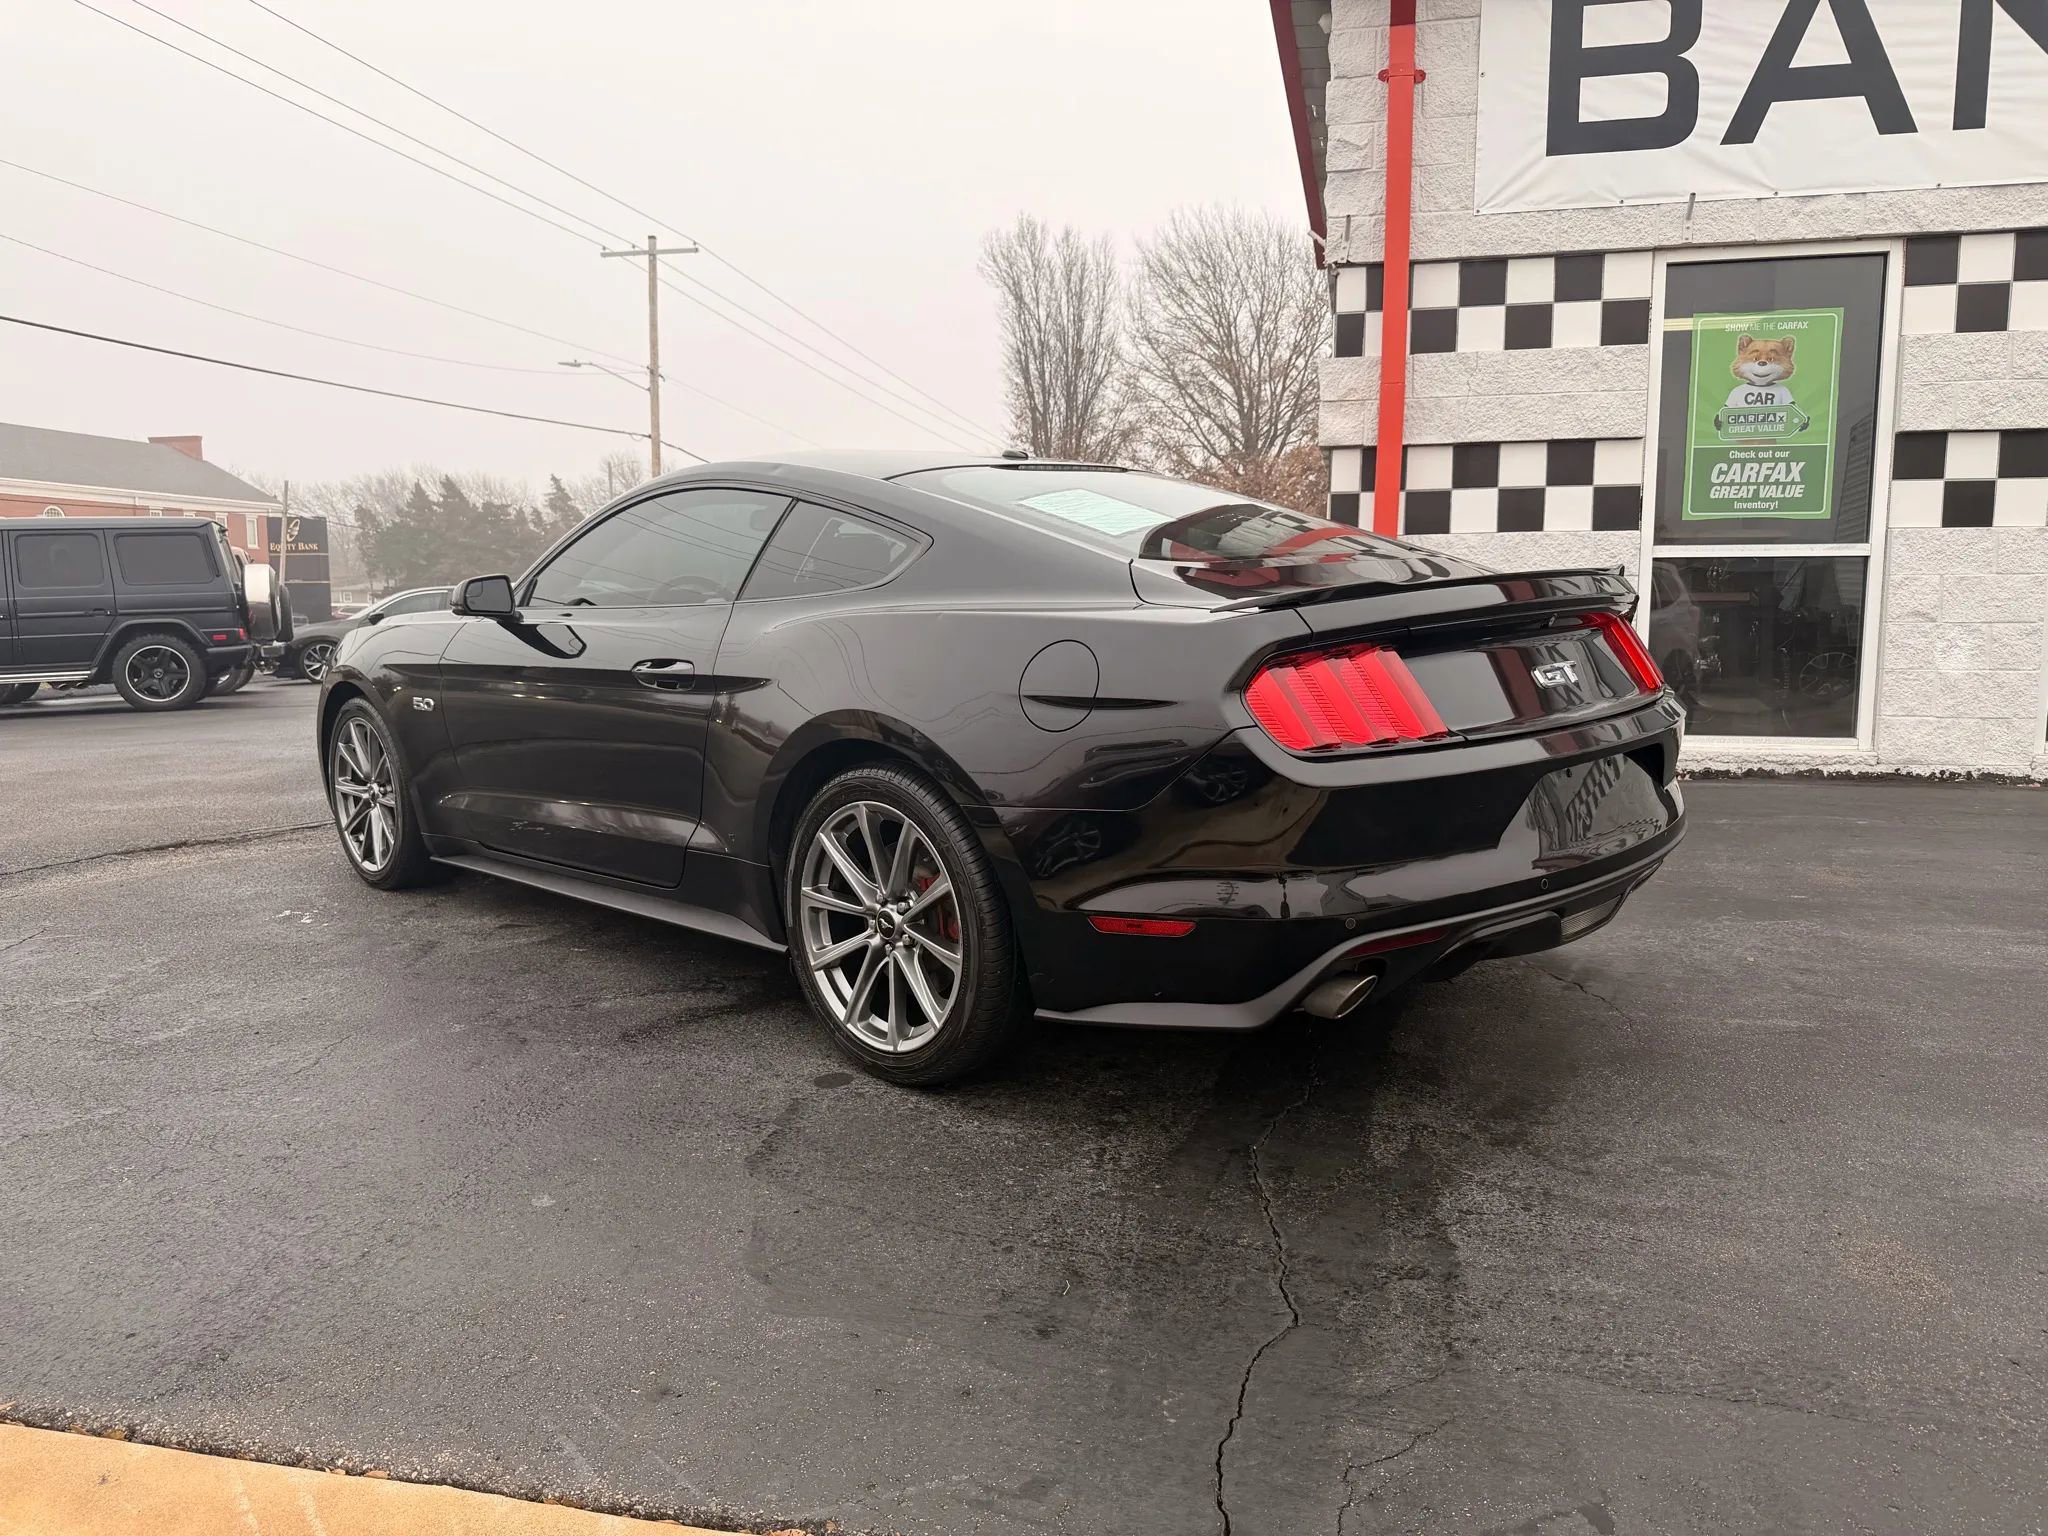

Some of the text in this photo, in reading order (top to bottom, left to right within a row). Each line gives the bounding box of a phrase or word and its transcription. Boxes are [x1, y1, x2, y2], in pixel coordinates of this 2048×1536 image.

[1725, 321, 1808, 332] SHOW ME THE CARFAX
[1744, 392, 1775, 405] CAR
[1728, 412, 1786, 424] CARFAX
[1728, 424, 1785, 433] GREAT VALUE
[1729, 450, 1790, 459] Check out our
[1710, 461, 1806, 483] CARFAX
[1709, 484, 1805, 499] GREAT VALUE
[1734, 501, 1779, 510] Inventory!
[270, 542, 297, 552] EQTY
[1531, 660, 1579, 689] GT
